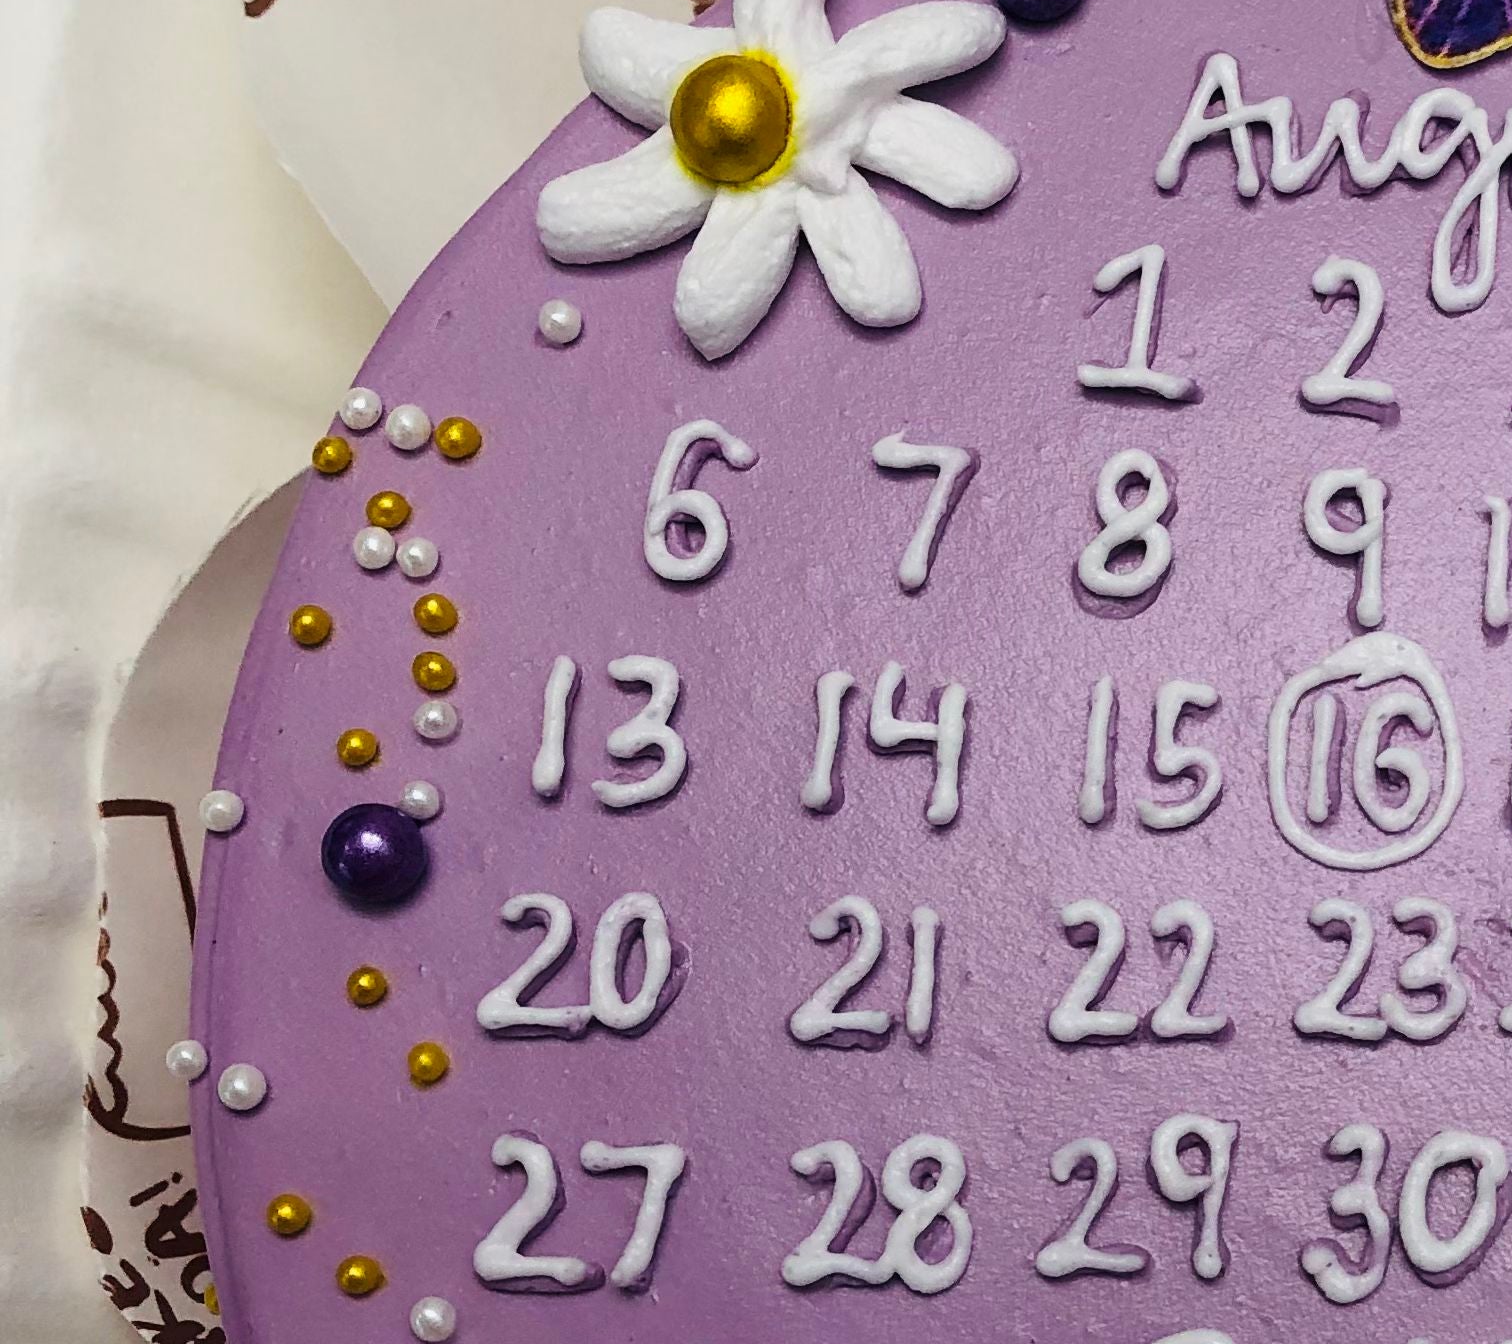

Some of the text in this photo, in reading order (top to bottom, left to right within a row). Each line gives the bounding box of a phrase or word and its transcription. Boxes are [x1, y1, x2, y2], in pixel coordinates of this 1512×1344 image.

[1077, 244, 1198, 400] 1
[1301, 256, 1396, 404] 2
[644, 420, 758, 583] 6
[873, 432, 977, 590] 7
[1077, 448, 1174, 597] 8
[1304, 468, 1385, 628] 9
[531, 654, 688, 808] 13
[800, 662, 966, 825] 14
[1080, 675, 1223, 830] 15
[1310, 690, 1433, 832] 16
[476, 892, 673, 1032] 20
[790, 896, 940, 1044] 21
[1048, 898, 1230, 1042] 22
[1294, 897, 1469, 1042] 23
[473, 1134, 686, 1288] 27
[780, 1134, 973, 1293] 28
[1036, 1113, 1237, 1279] 29
[1302, 1125, 1508, 1305] 30
